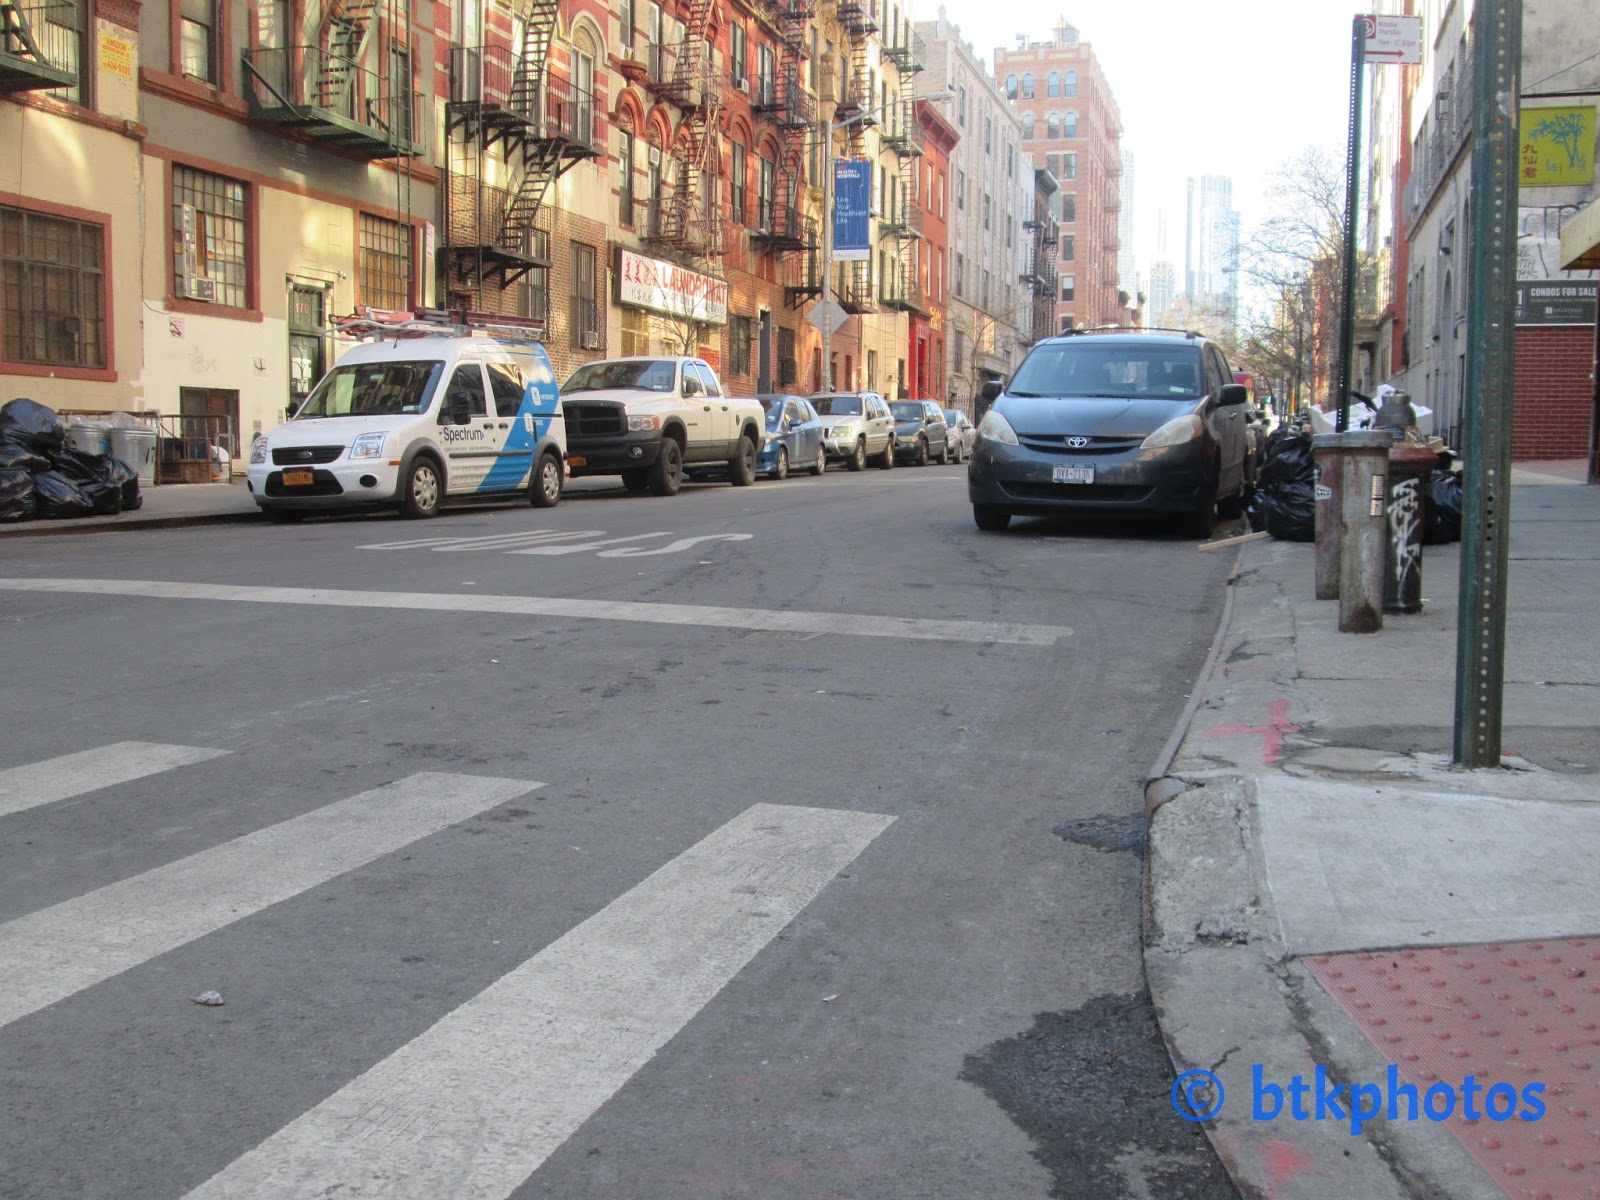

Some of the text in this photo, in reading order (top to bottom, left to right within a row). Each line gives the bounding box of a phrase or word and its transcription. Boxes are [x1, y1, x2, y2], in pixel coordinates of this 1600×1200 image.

[662, 265, 727, 304] LAUNDROMAT
[1531, 287, 1598, 297] CONDOS FOR SALE
[443, 426, 483, 445] Spectrum
